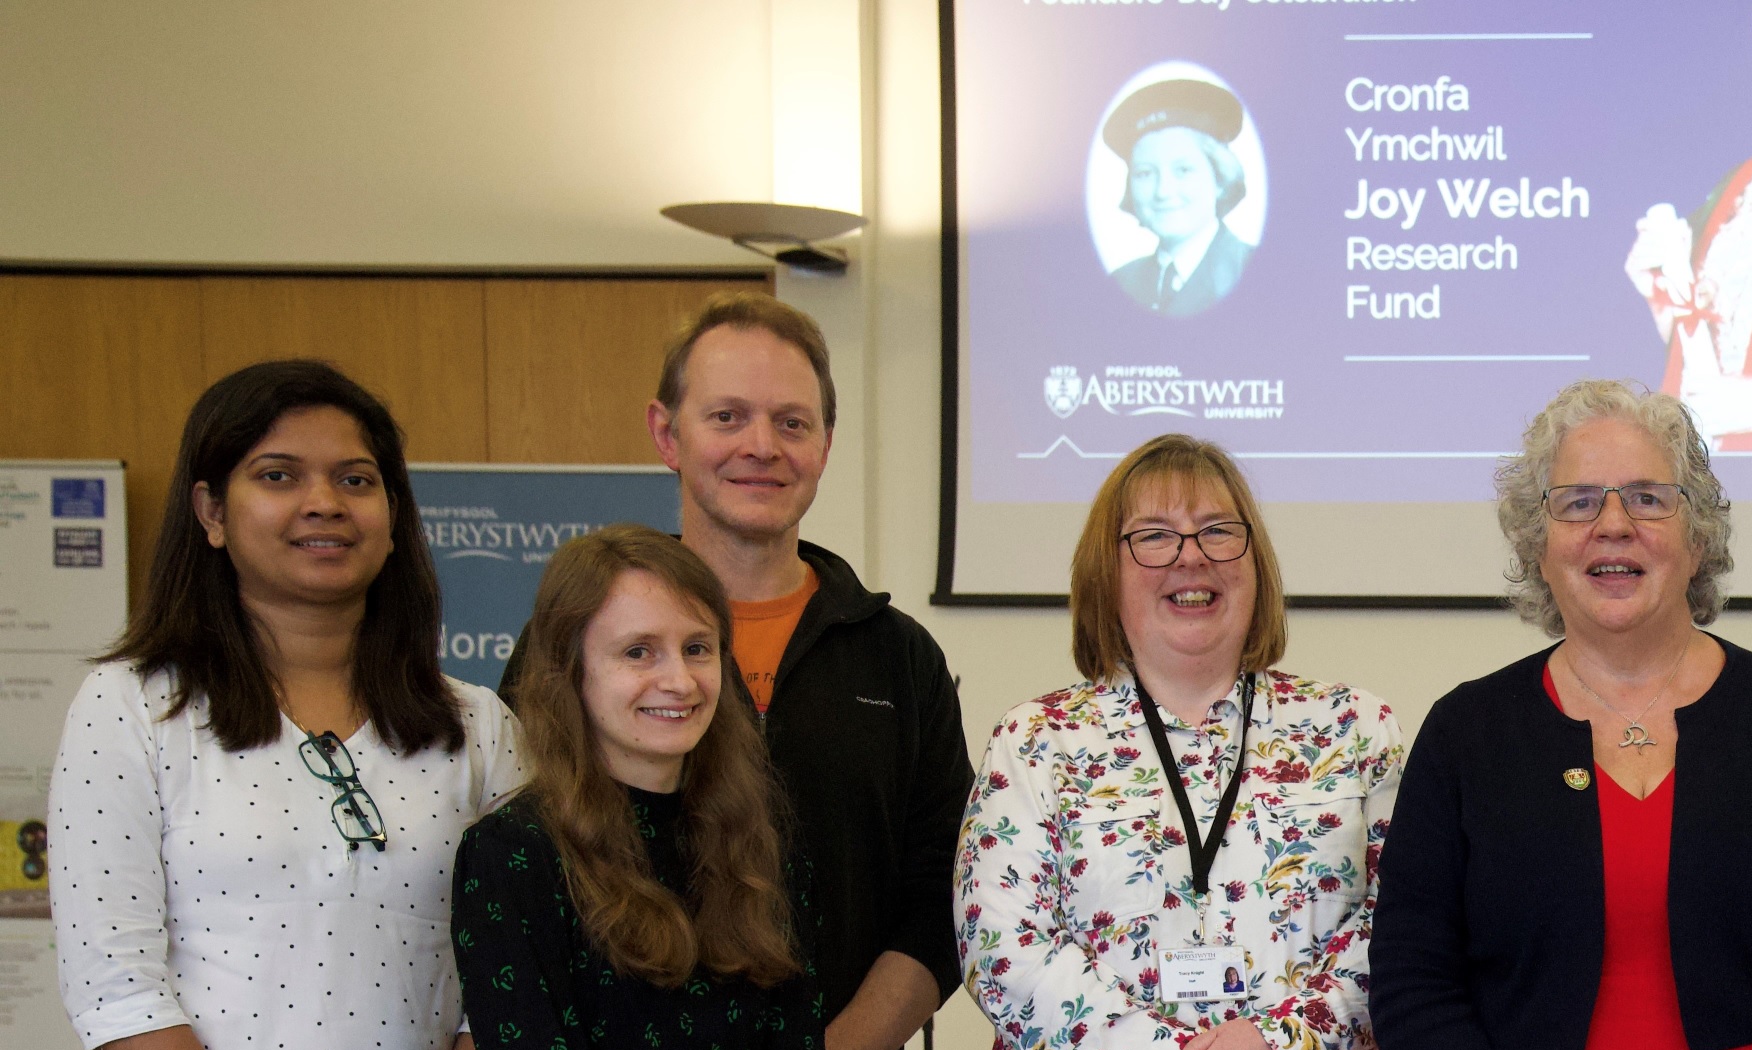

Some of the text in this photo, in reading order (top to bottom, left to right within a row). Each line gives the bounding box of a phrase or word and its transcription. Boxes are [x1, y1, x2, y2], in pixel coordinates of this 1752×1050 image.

[1345, 75, 1469, 112] Cronfa
[1345, 125, 1507, 161] Ymchwil
[1344, 177, 1590, 230] Joy Welch
[1347, 235, 1518, 271] Research
[1347, 284, 1440, 319] Fund
[1082, 374, 1284, 413] ABERYSTWYTH
[1204, 408, 1284, 419] UNIVERSITY
